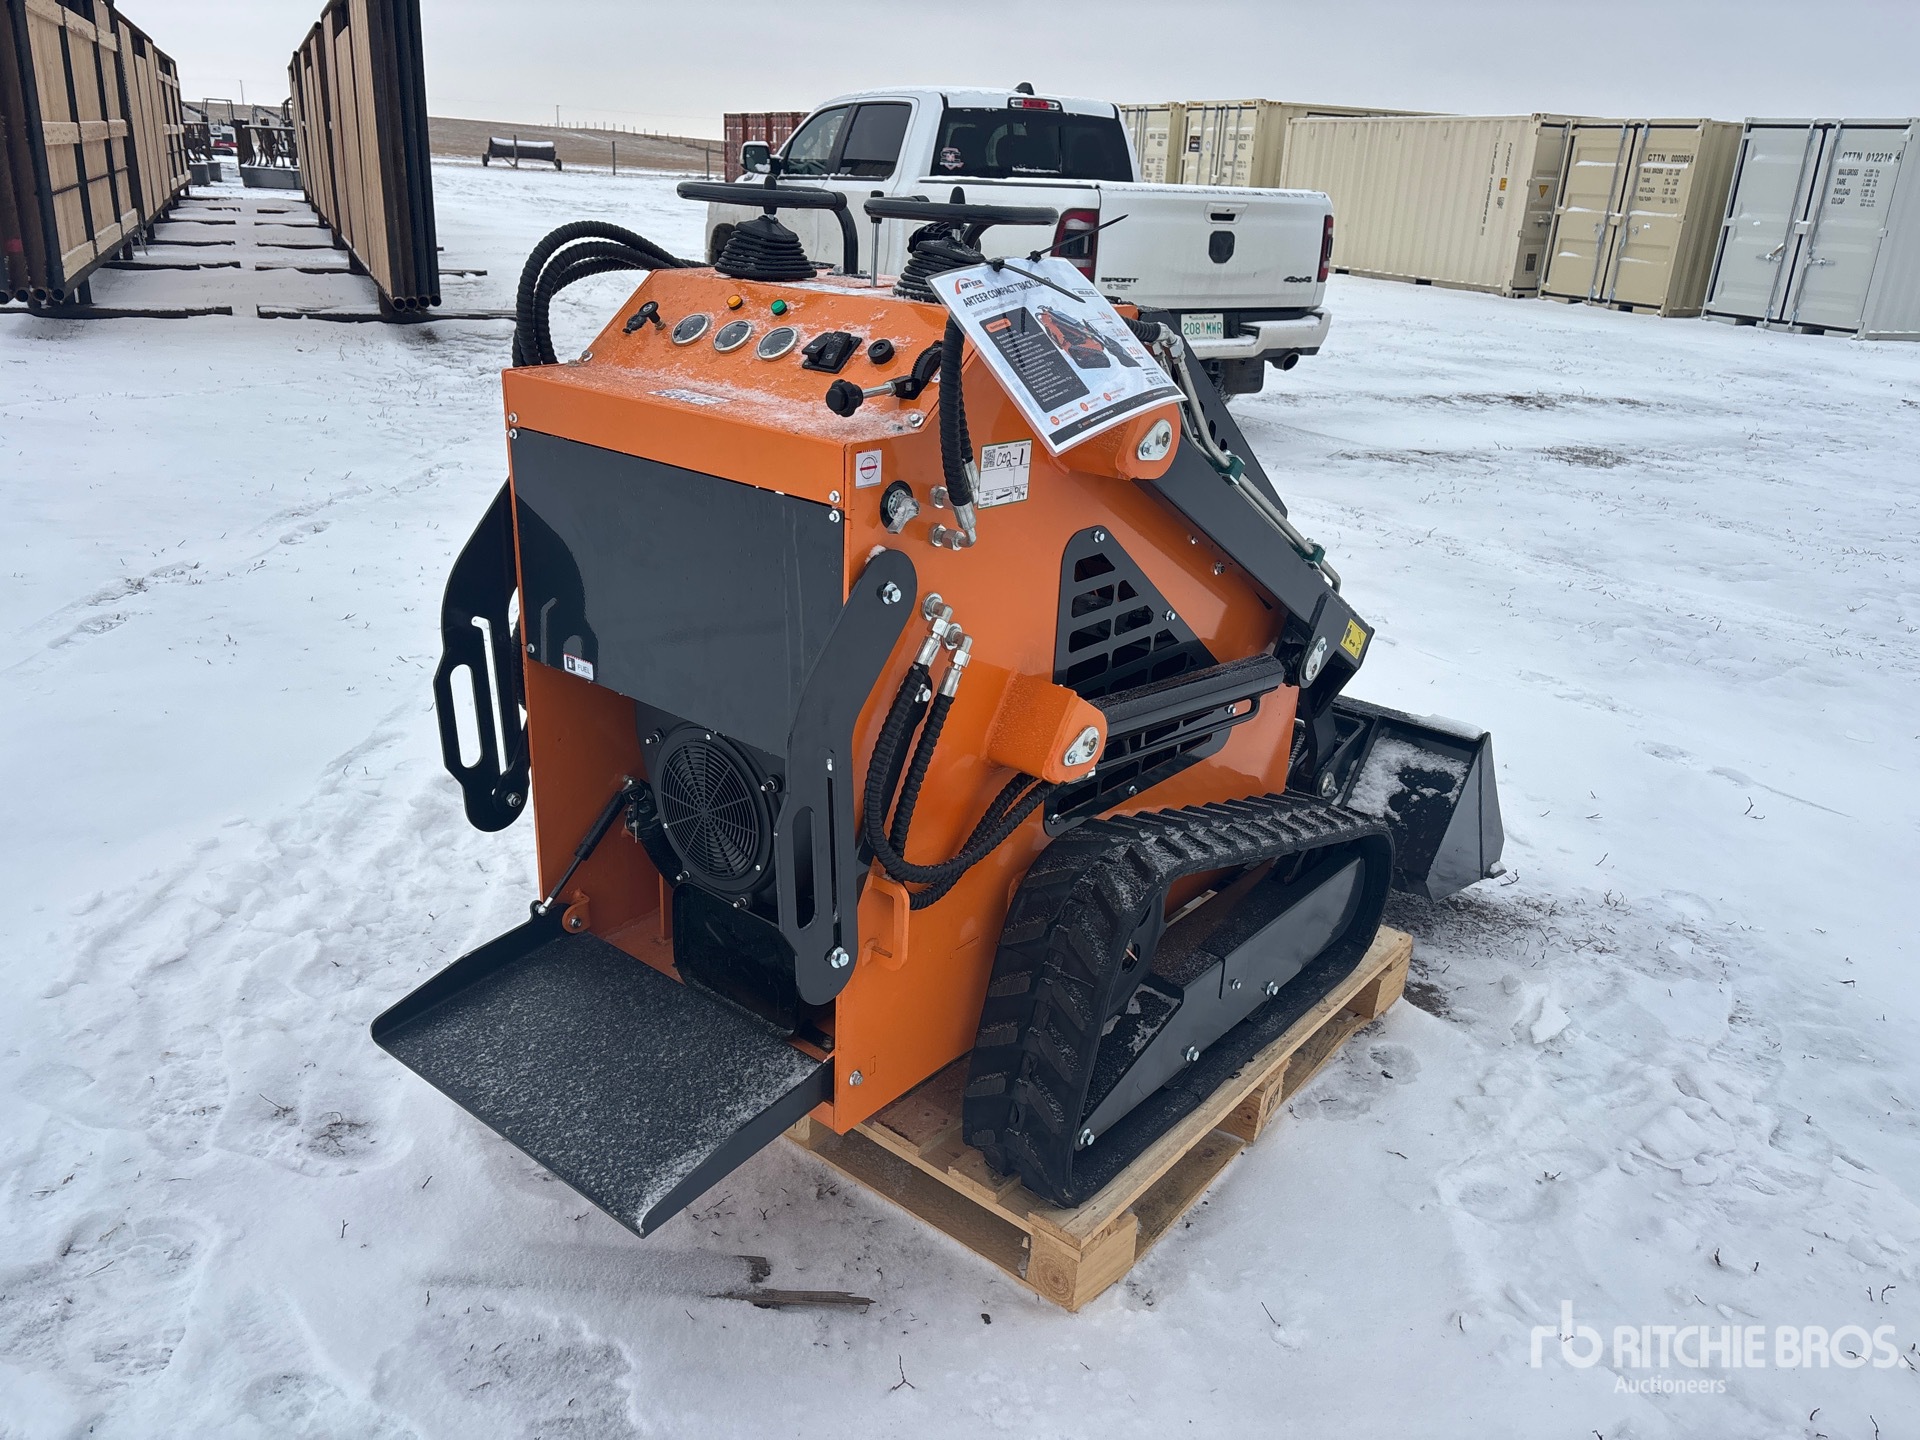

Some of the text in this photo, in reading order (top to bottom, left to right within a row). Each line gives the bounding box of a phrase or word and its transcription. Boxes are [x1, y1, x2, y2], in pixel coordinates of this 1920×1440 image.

[1842, 152, 1863, 161] CTTN
[961, 279, 983, 290] ARTEER
[963, 293, 990, 308] ARTEER
[988, 284, 1018, 299] COMPACT
[1014, 279, 1033, 292] TRACK
[1183, 321, 1222, 335] 208 MWR
[577, 664, 590, 674] FUEL
